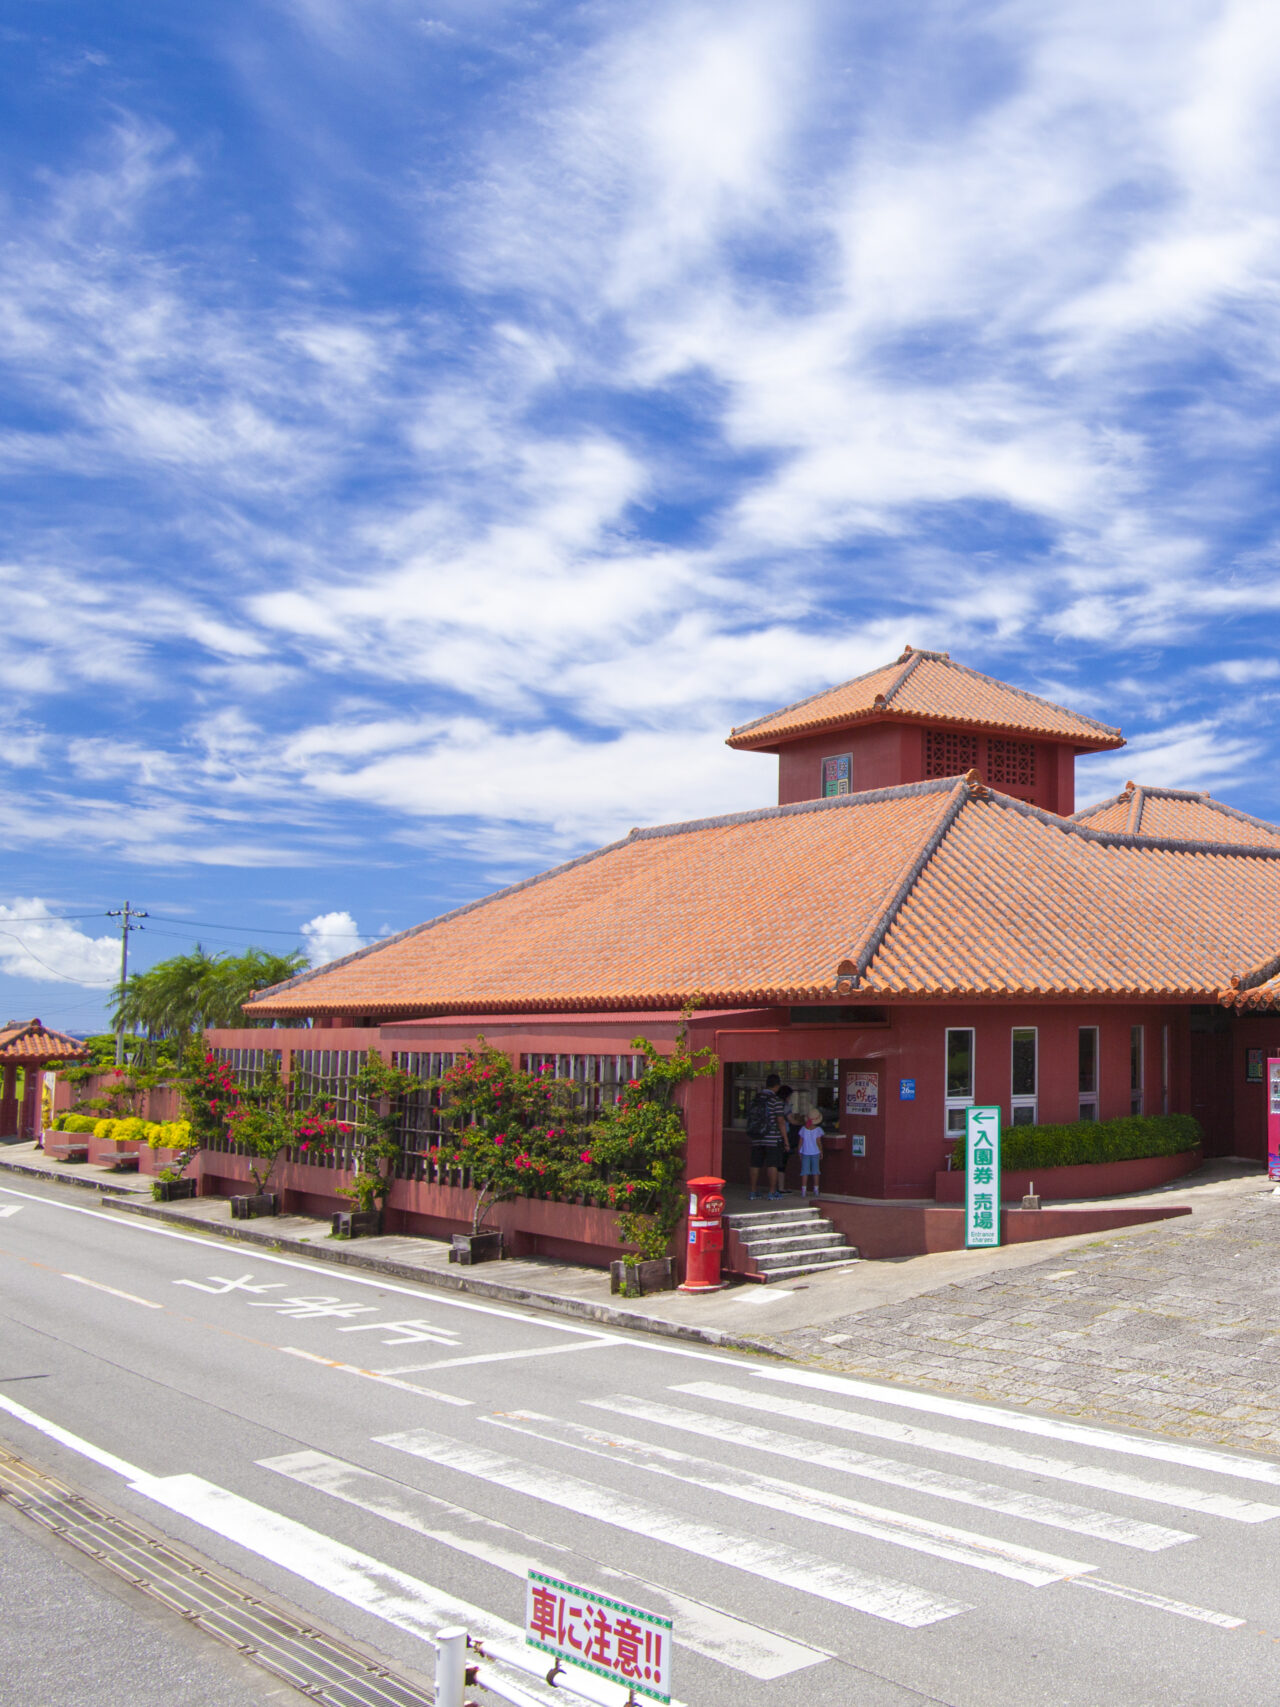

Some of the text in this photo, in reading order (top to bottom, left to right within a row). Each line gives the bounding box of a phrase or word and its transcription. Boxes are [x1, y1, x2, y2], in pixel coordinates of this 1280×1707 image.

[973, 1130, 993, 1229] 入園券 売場
[530, 1586, 662, 1684] 車に注意!!
